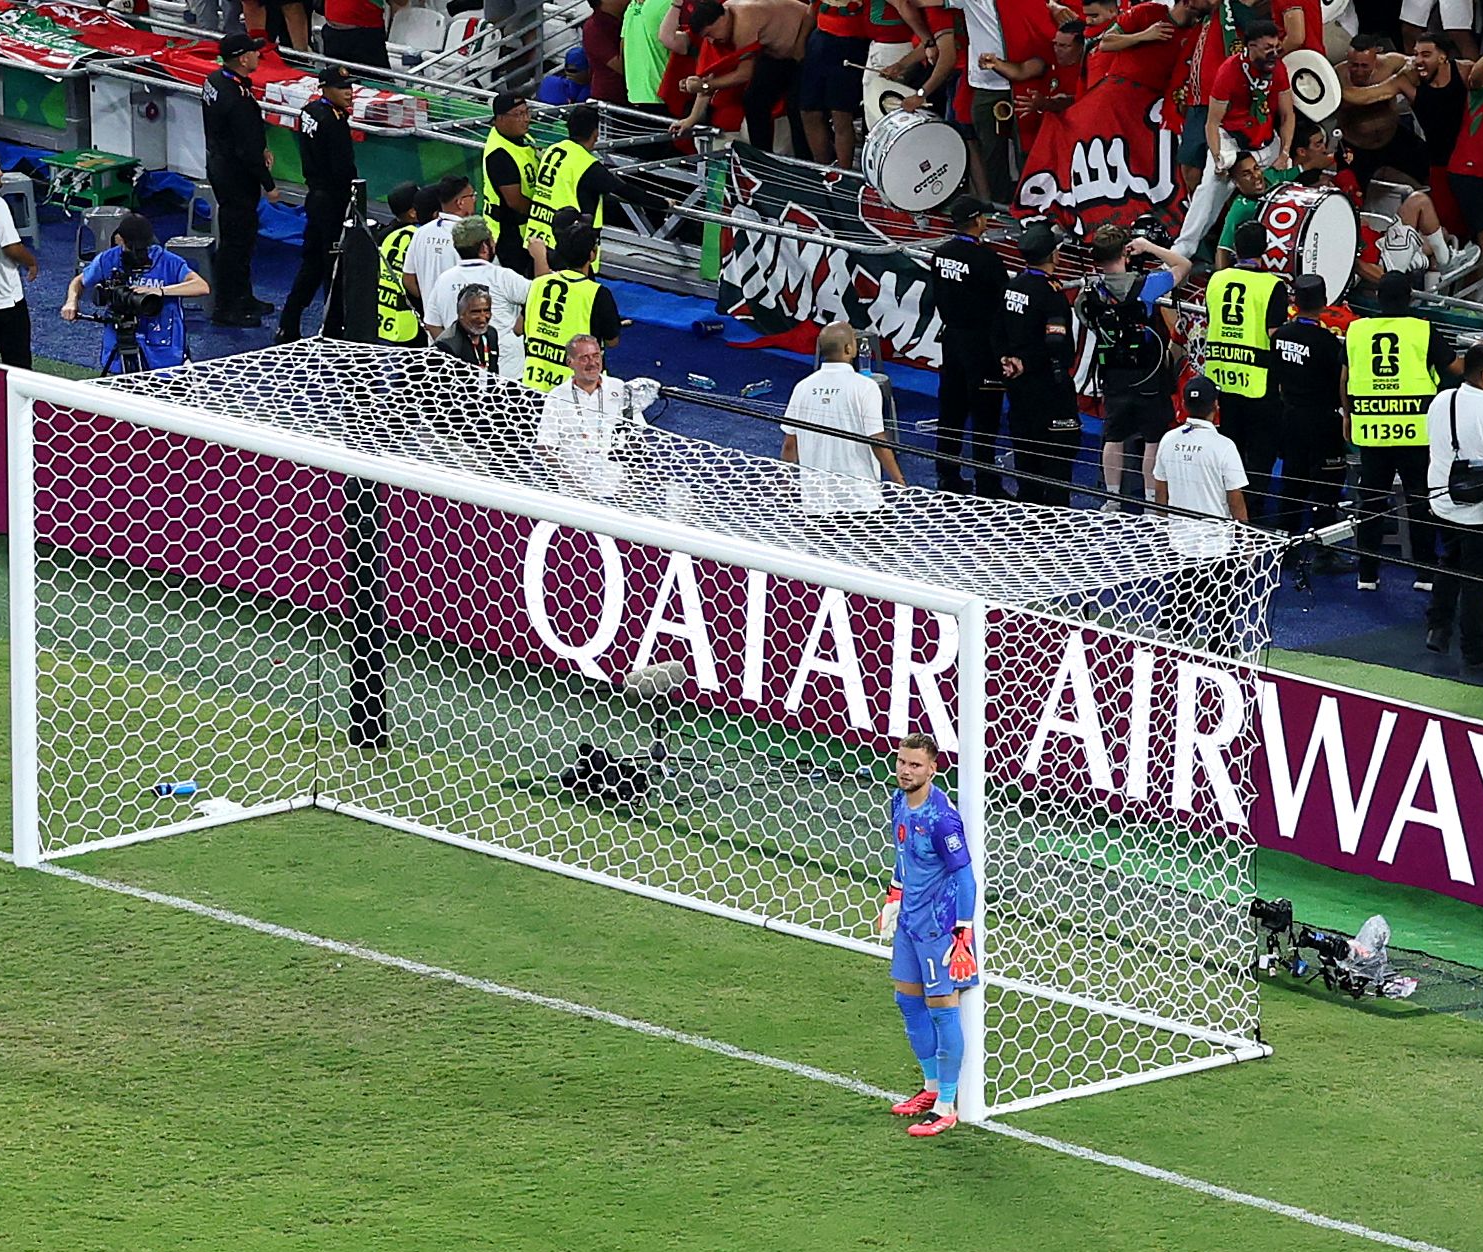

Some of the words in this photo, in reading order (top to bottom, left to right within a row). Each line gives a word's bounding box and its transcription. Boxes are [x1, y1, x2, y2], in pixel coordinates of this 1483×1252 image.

[426, 237, 451, 246] STAFF
[936, 257, 970, 274] FUERZA
[941, 268, 963, 282] CIVIL
[1004, 289, 1030, 306] FUERZA
[1006, 300, 1025, 314] CIVIL
[1276, 339, 1310, 358] FUERZA
[1282, 352, 1304, 365] CIVIL
[812, 388, 841, 396] STAFF
[1372, 383, 1400, 391] 2026
[1354, 399, 1422, 413] SECURITY
[1360, 423, 1417, 440] 11396
[1174, 443, 1203, 453] STAFF
[927, 958, 936, 981] 1
